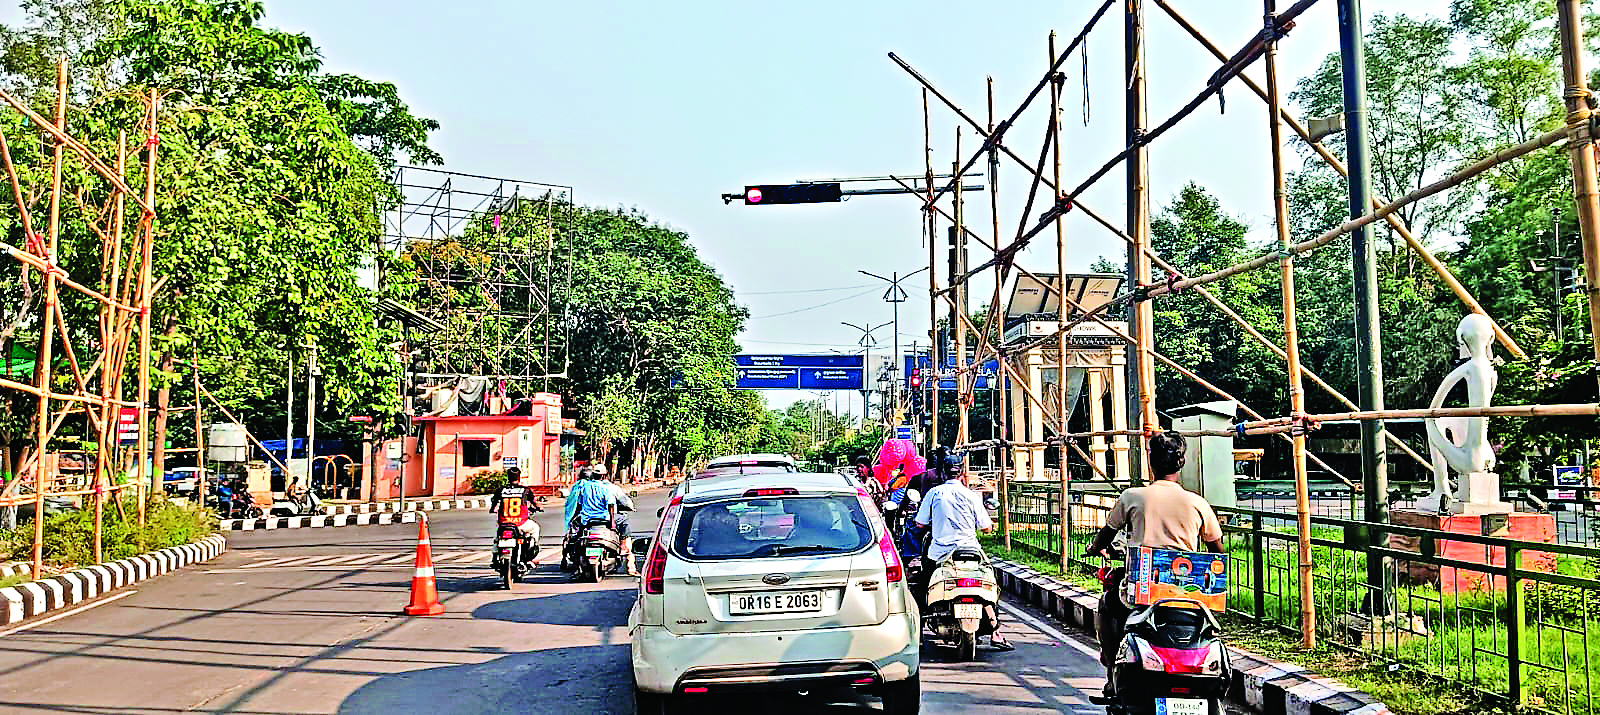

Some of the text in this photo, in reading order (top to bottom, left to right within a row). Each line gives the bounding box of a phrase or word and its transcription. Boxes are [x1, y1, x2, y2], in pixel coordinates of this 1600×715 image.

[503, 498, 522, 517] 18
[739, 595, 771, 610] OR16
[775, 596, 783, 609] E
[787, 594, 818, 608] 2063
